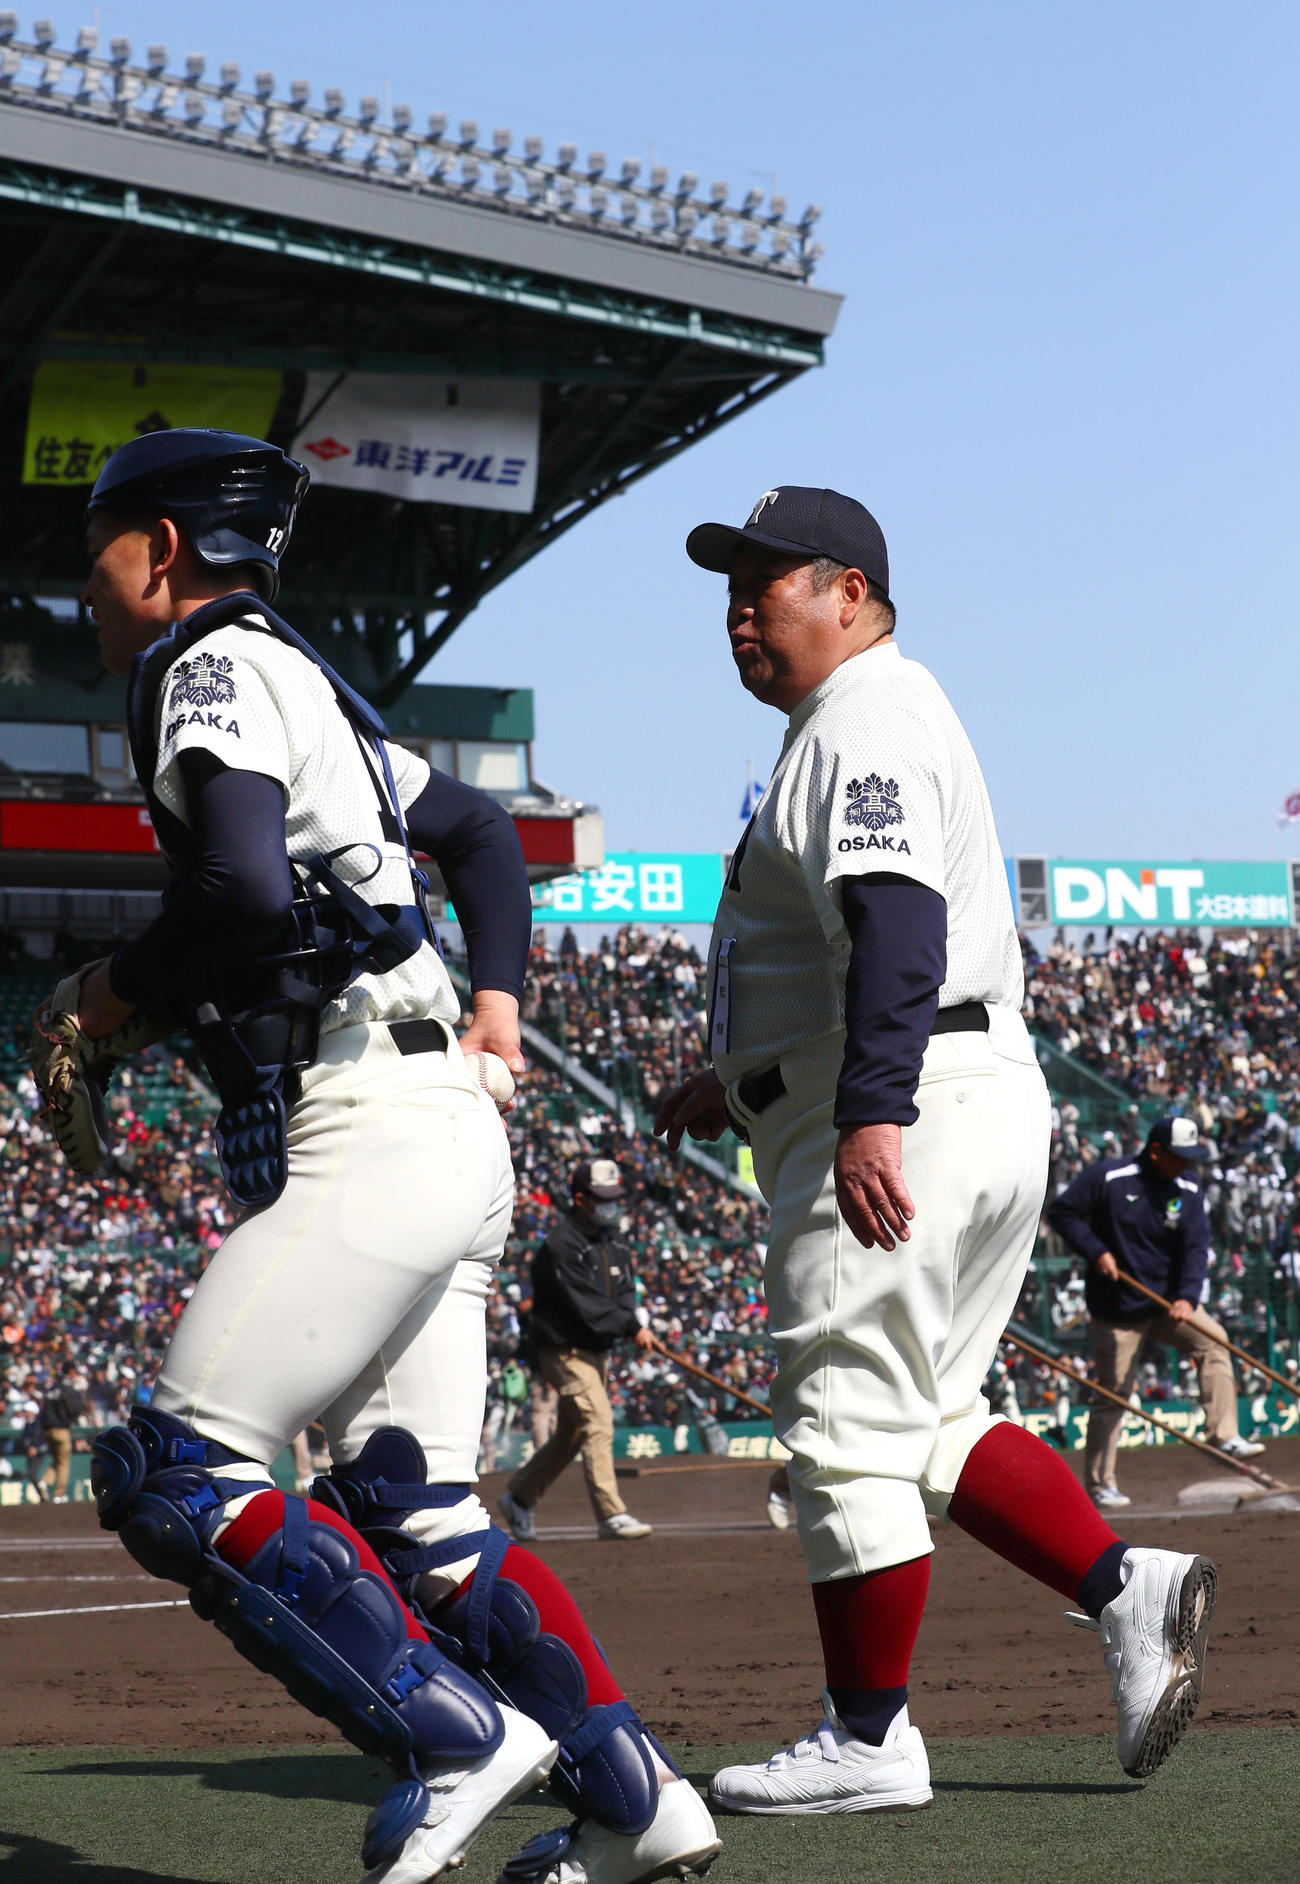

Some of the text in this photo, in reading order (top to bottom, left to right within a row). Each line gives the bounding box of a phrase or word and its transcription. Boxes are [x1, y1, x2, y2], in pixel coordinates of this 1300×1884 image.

[353, 439, 527, 486] 東洋アルミ
[266, 527, 284, 553] 12
[164, 709, 241, 748] OSAKA
[838, 833, 911, 856] OSAKA
[1053, 867, 1204, 920] DNT
